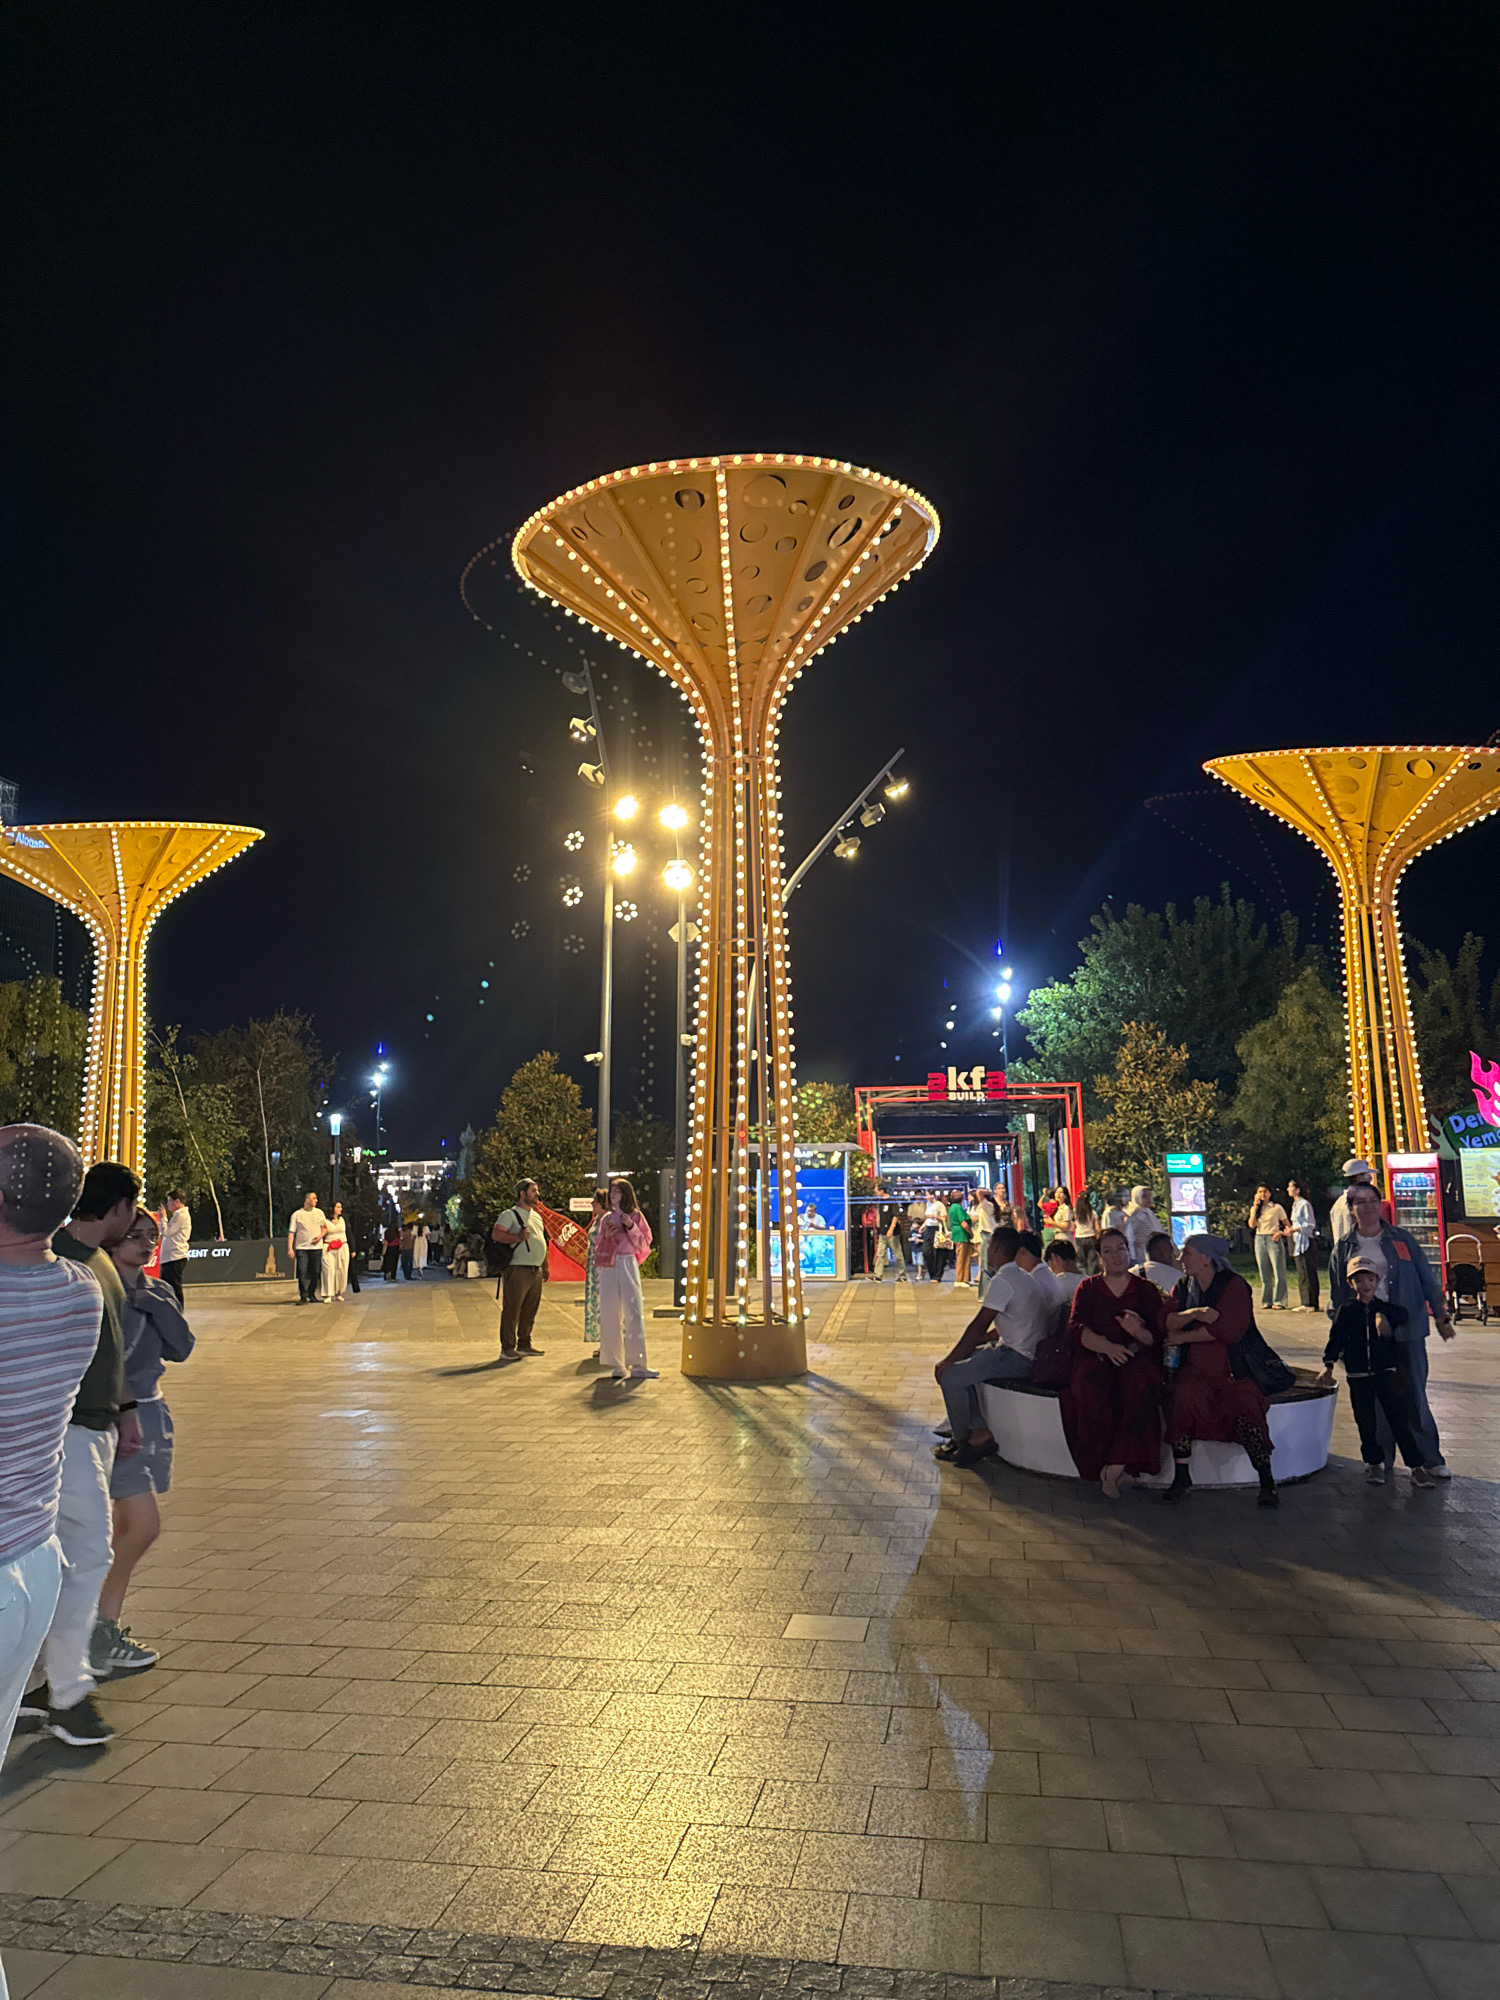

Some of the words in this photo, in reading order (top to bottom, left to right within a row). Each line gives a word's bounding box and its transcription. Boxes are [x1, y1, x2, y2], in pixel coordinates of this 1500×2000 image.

[927, 1066, 1006, 1091] akfa
[948, 1091, 985, 1101] BUILD
[211, 1248, 231, 1257] CITY
